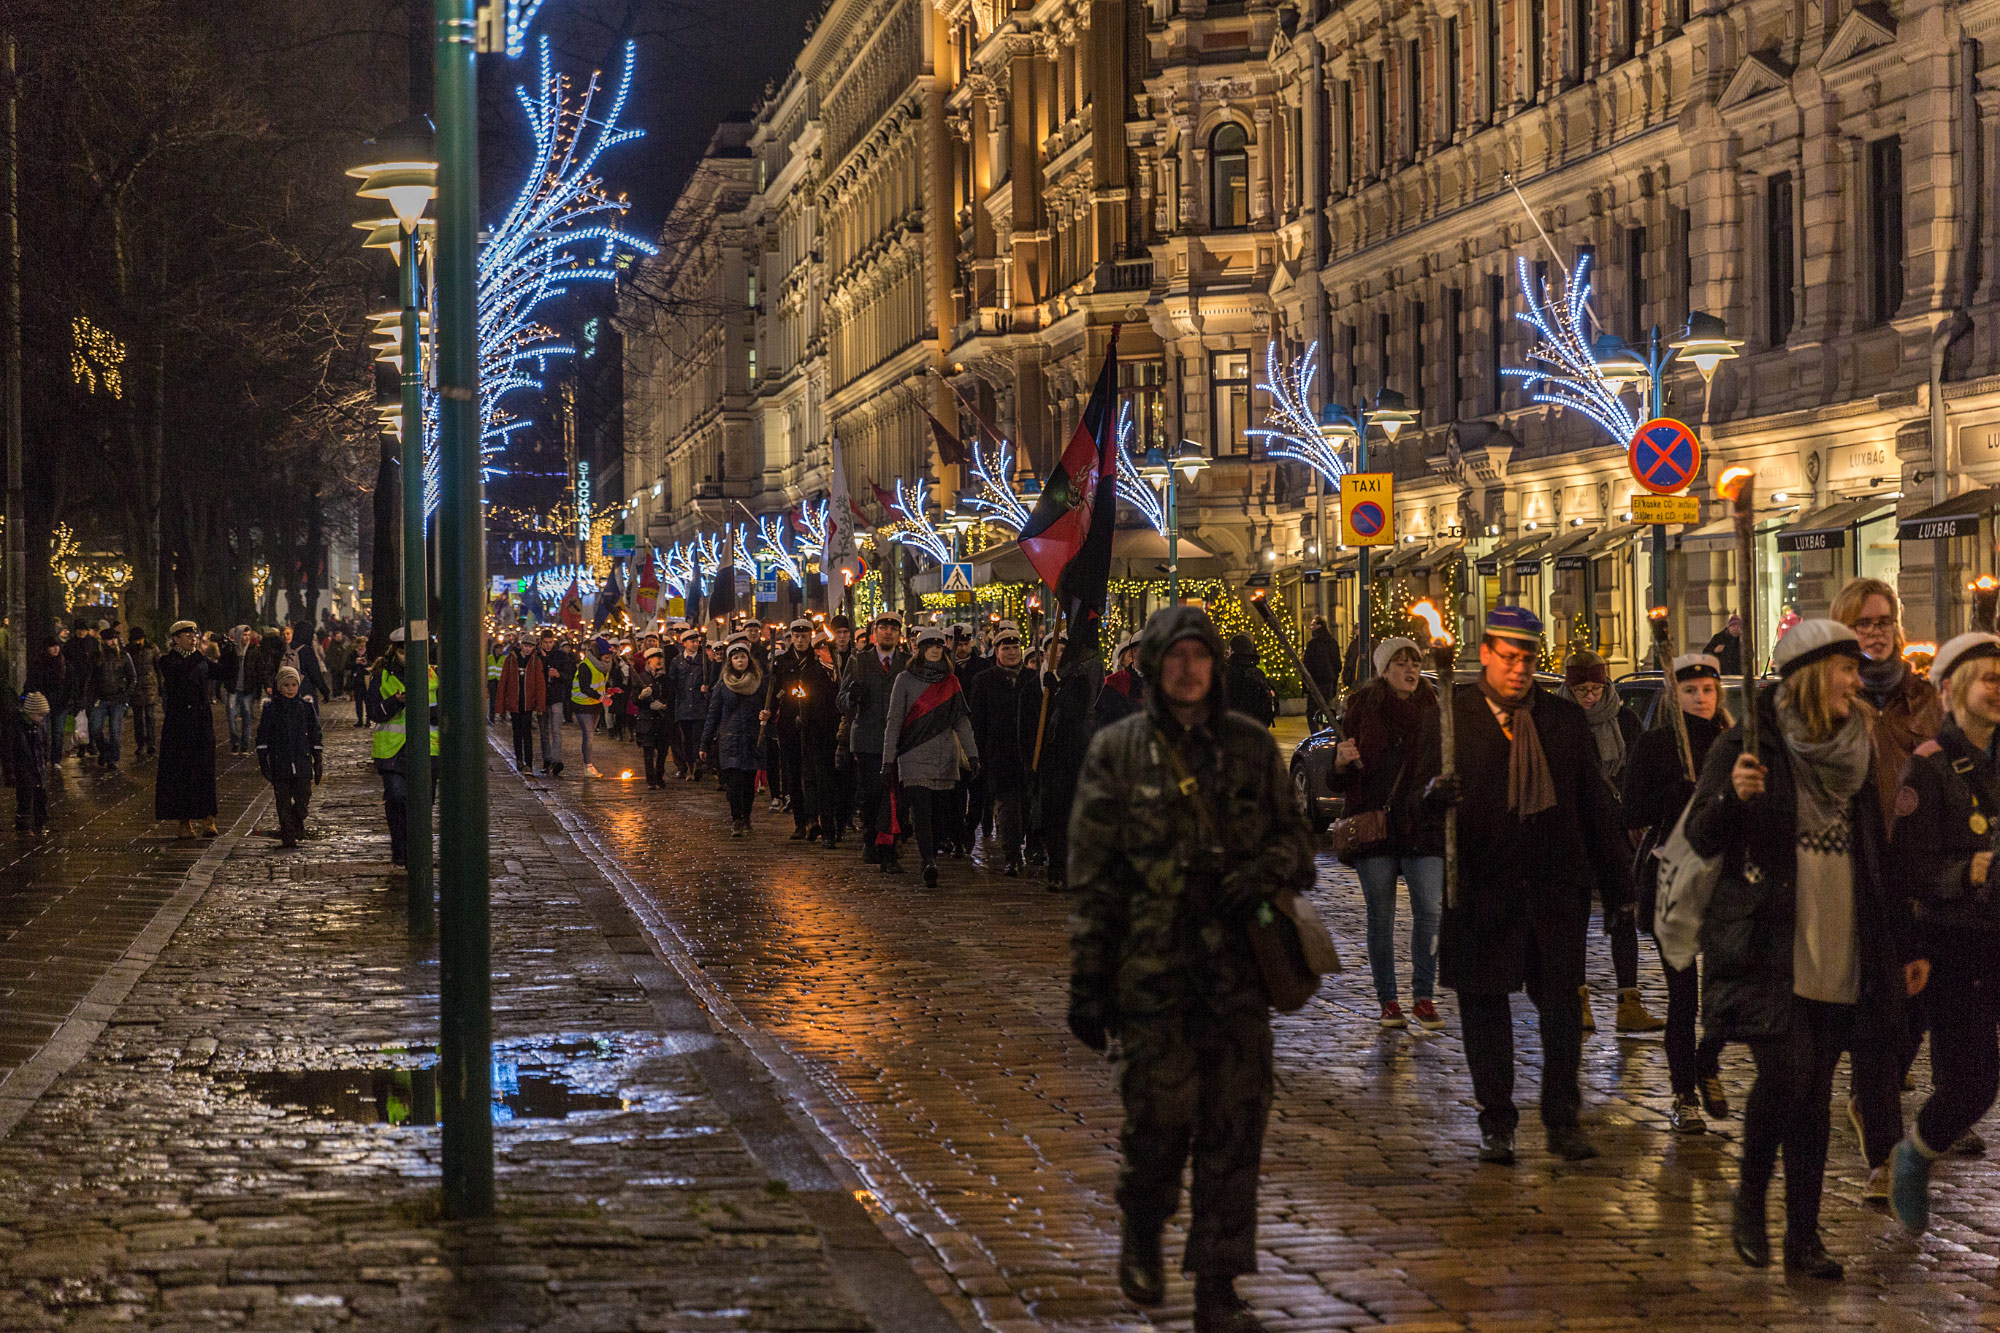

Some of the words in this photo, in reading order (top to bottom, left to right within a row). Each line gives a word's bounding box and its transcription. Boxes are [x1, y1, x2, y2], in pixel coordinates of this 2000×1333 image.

[1849, 449, 1885, 468] LUXBAG
[1352, 479, 1381, 493] TAXI
[577, 461, 591, 541] STOCKMANN
[1918, 520, 1956, 539] LUXBAG
[1794, 534, 1826, 550] LUXBAG
